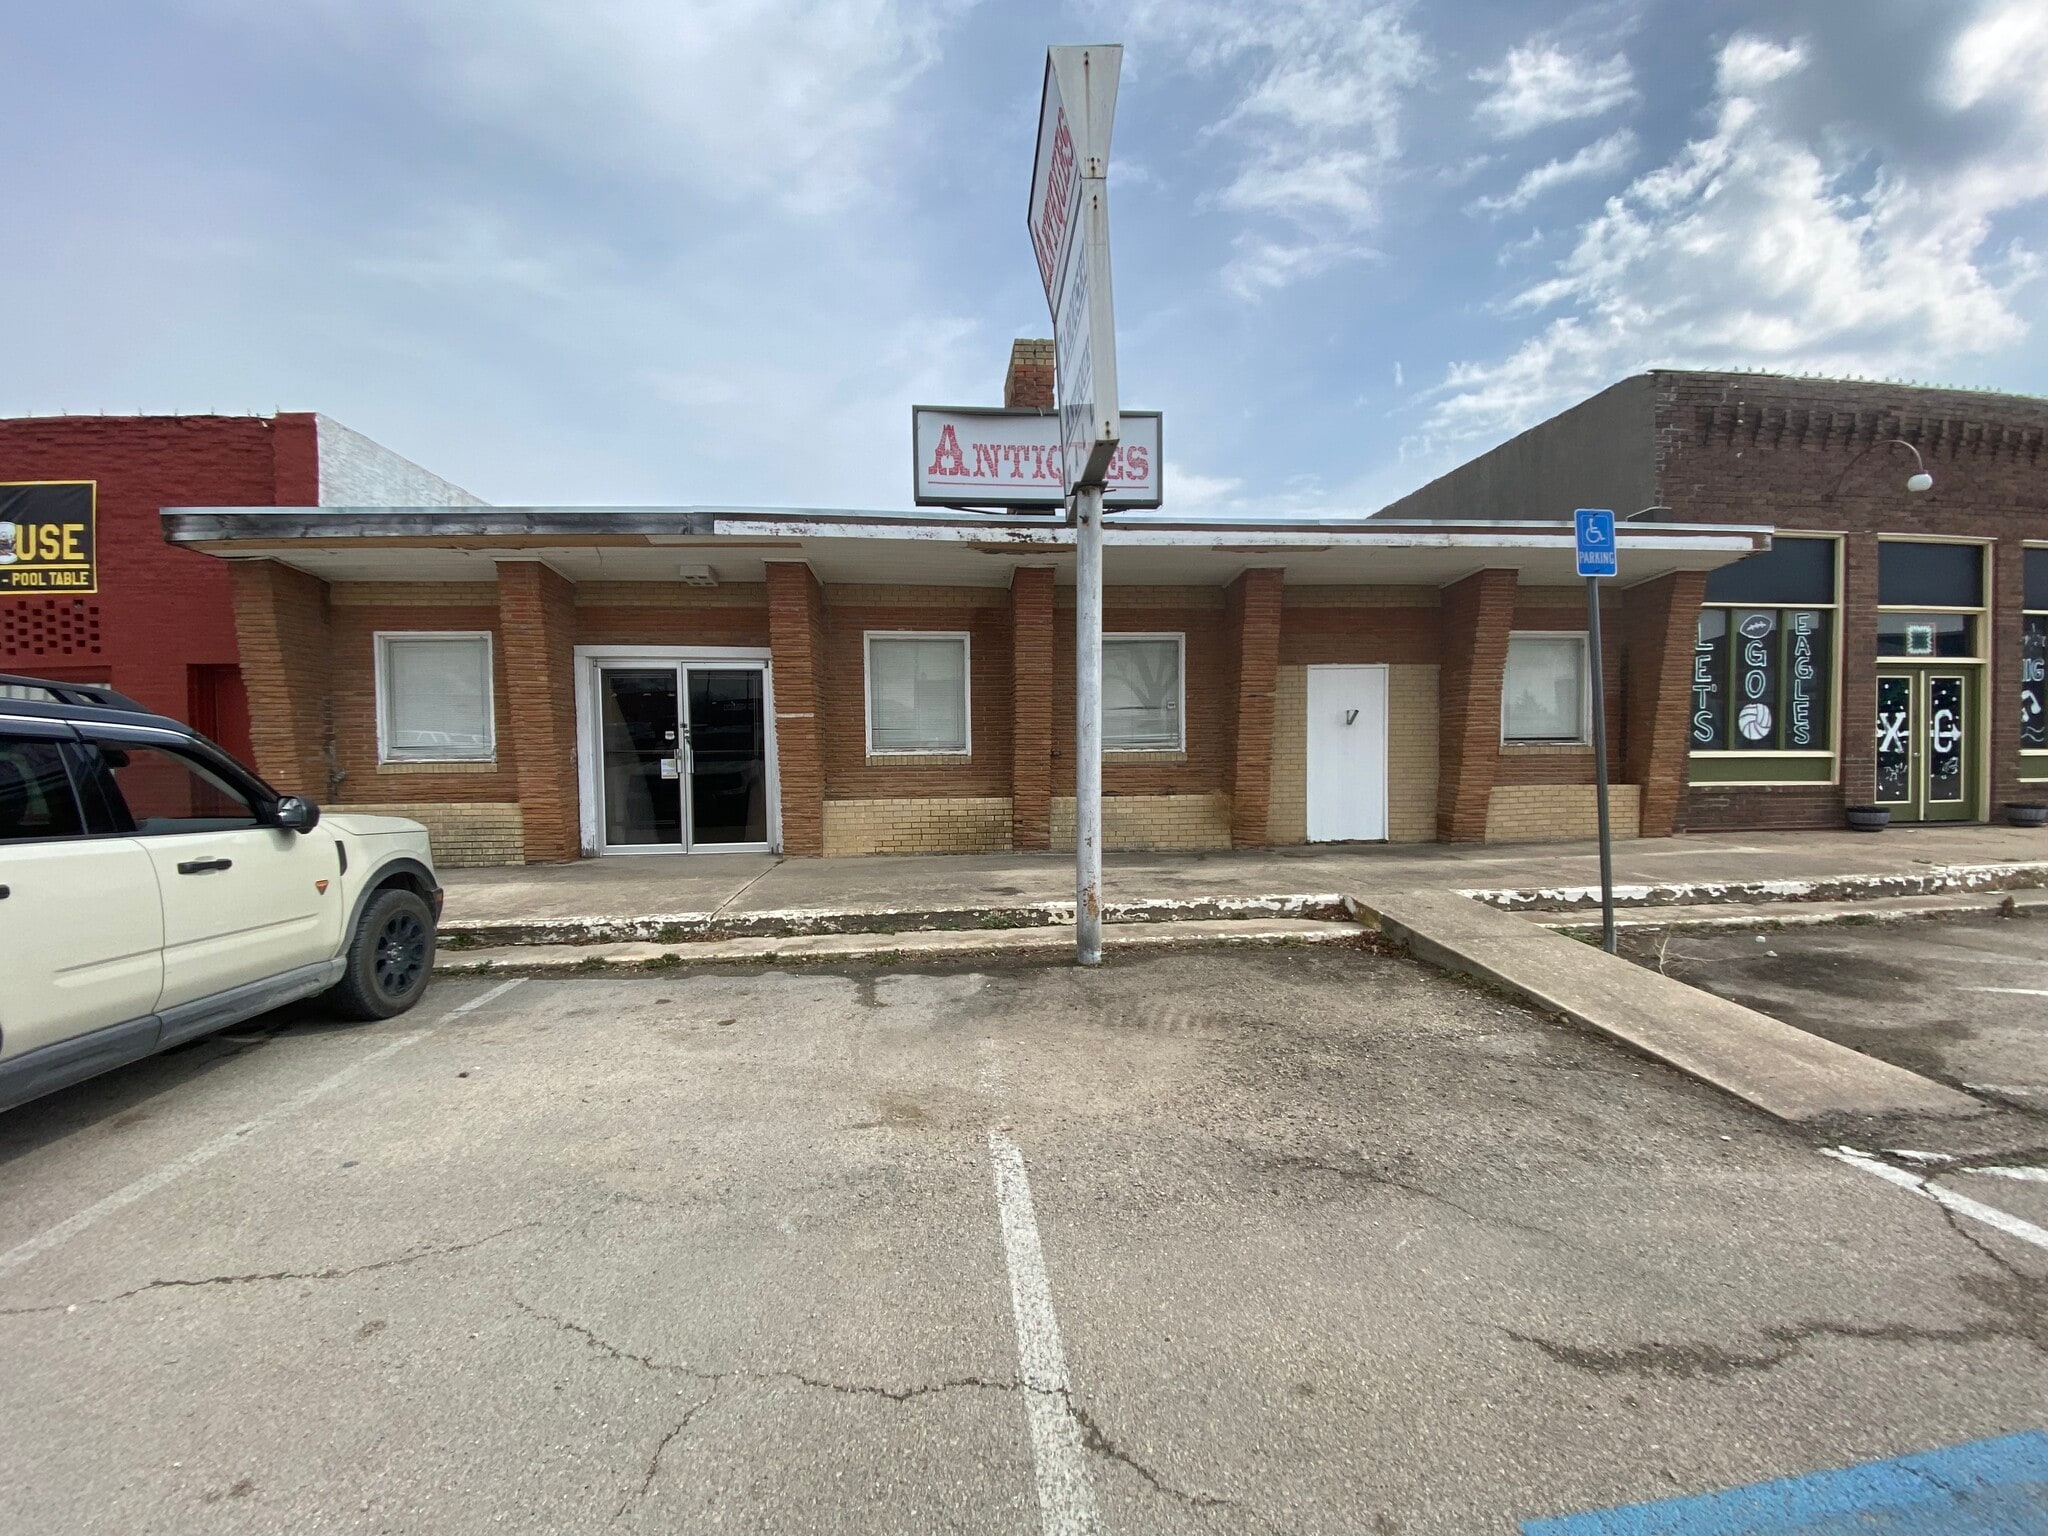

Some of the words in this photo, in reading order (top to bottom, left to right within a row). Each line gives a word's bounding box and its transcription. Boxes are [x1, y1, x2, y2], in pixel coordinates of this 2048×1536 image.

[928, 424, 1149, 487] ANTIQES
[1579, 551, 1615, 565] PARKING
[12, 572, 47, 586] POOL
[49, 571, 89, 586] TABLE
[1692, 622, 1717, 742] LET'S
[1744, 640, 1767, 699] GO
[1793, 612, 1813, 744] EAGLES
